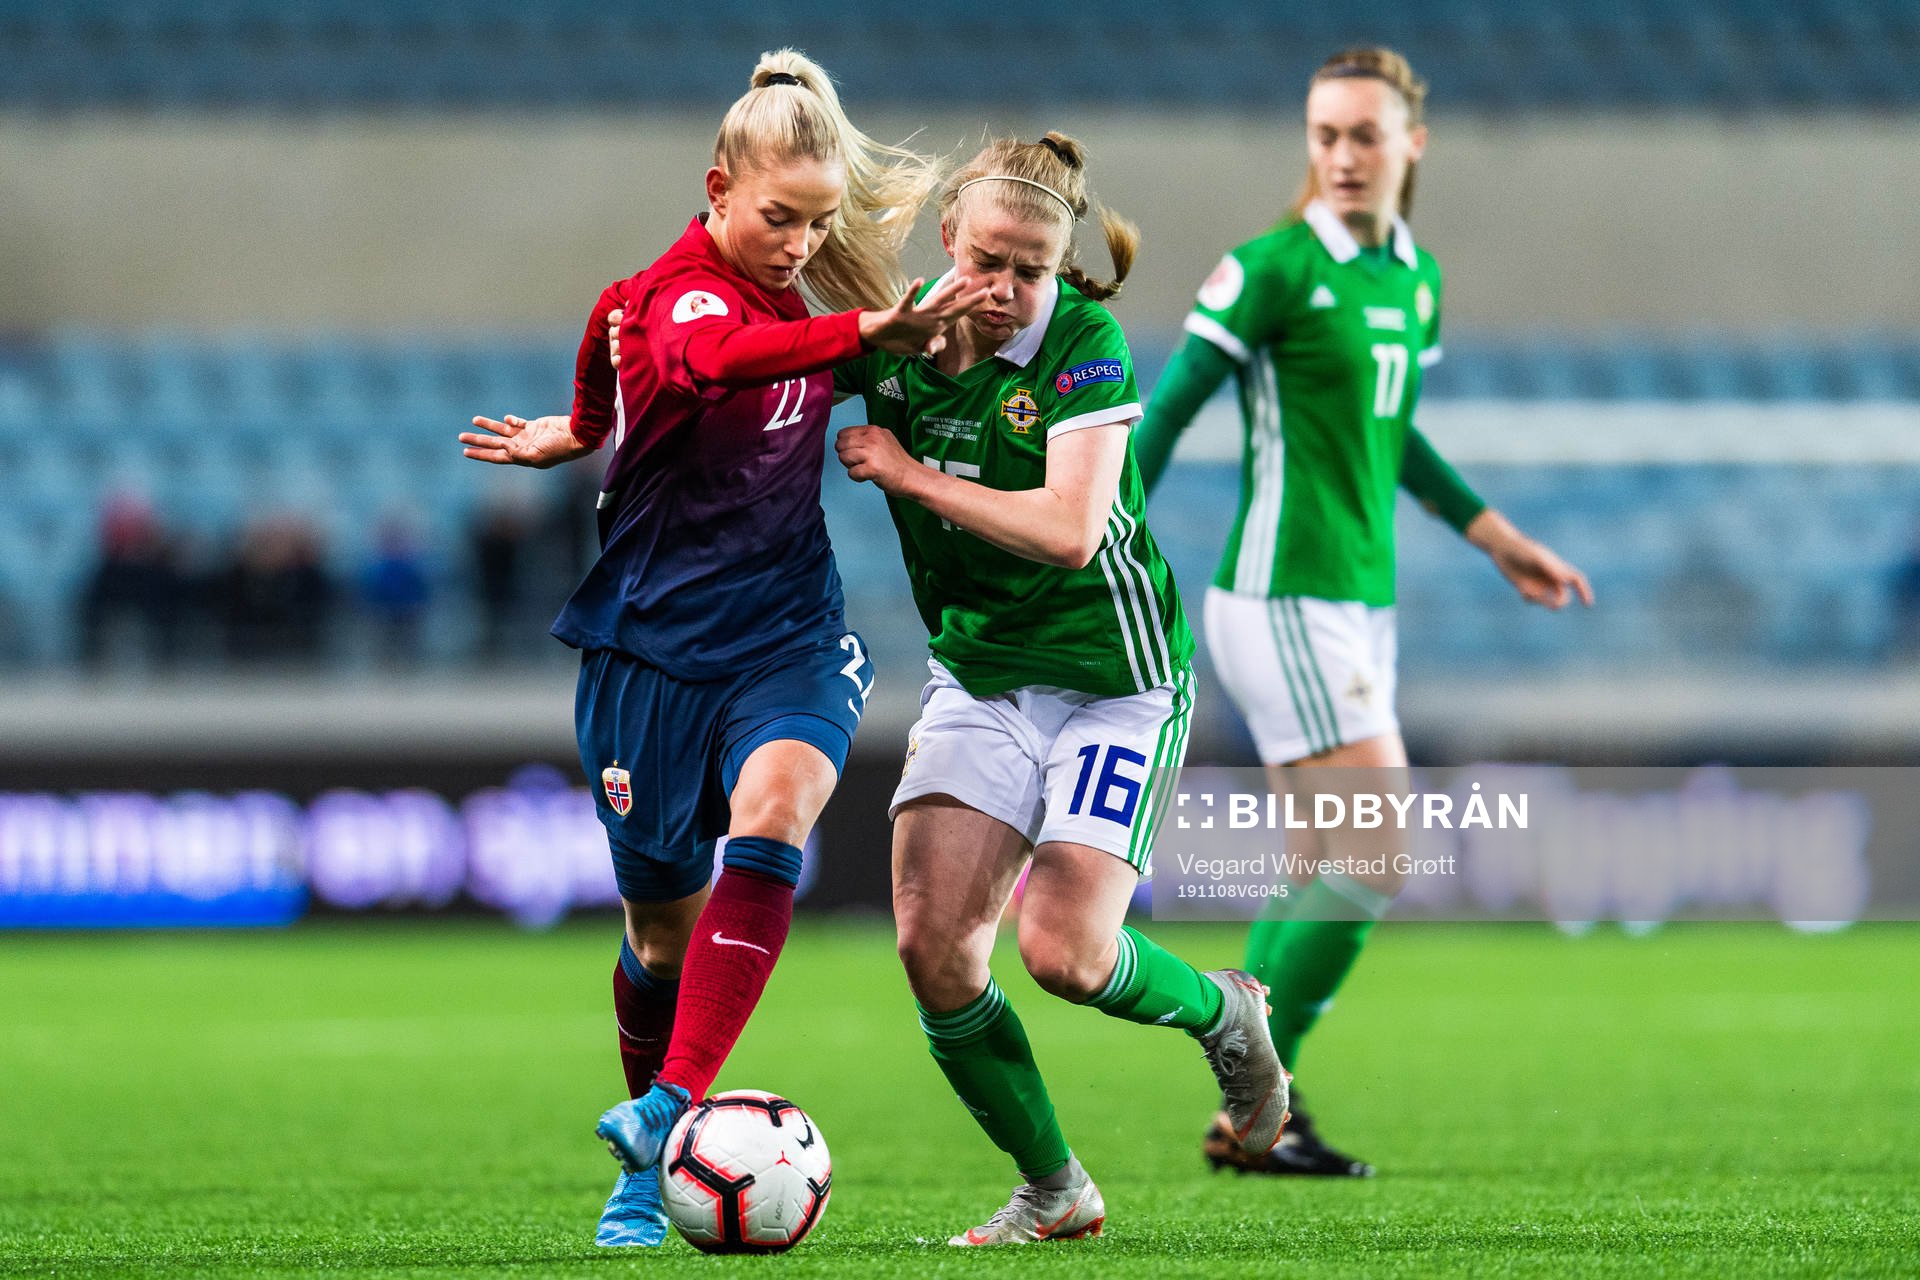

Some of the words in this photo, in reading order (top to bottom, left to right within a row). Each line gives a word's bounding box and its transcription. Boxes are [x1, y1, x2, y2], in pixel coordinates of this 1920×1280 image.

[1073, 365, 1122, 383] RESPECT
[763, 376, 807, 431] 22
[876, 385, 905, 400] adidas
[1068, 744, 1146, 828] 16
